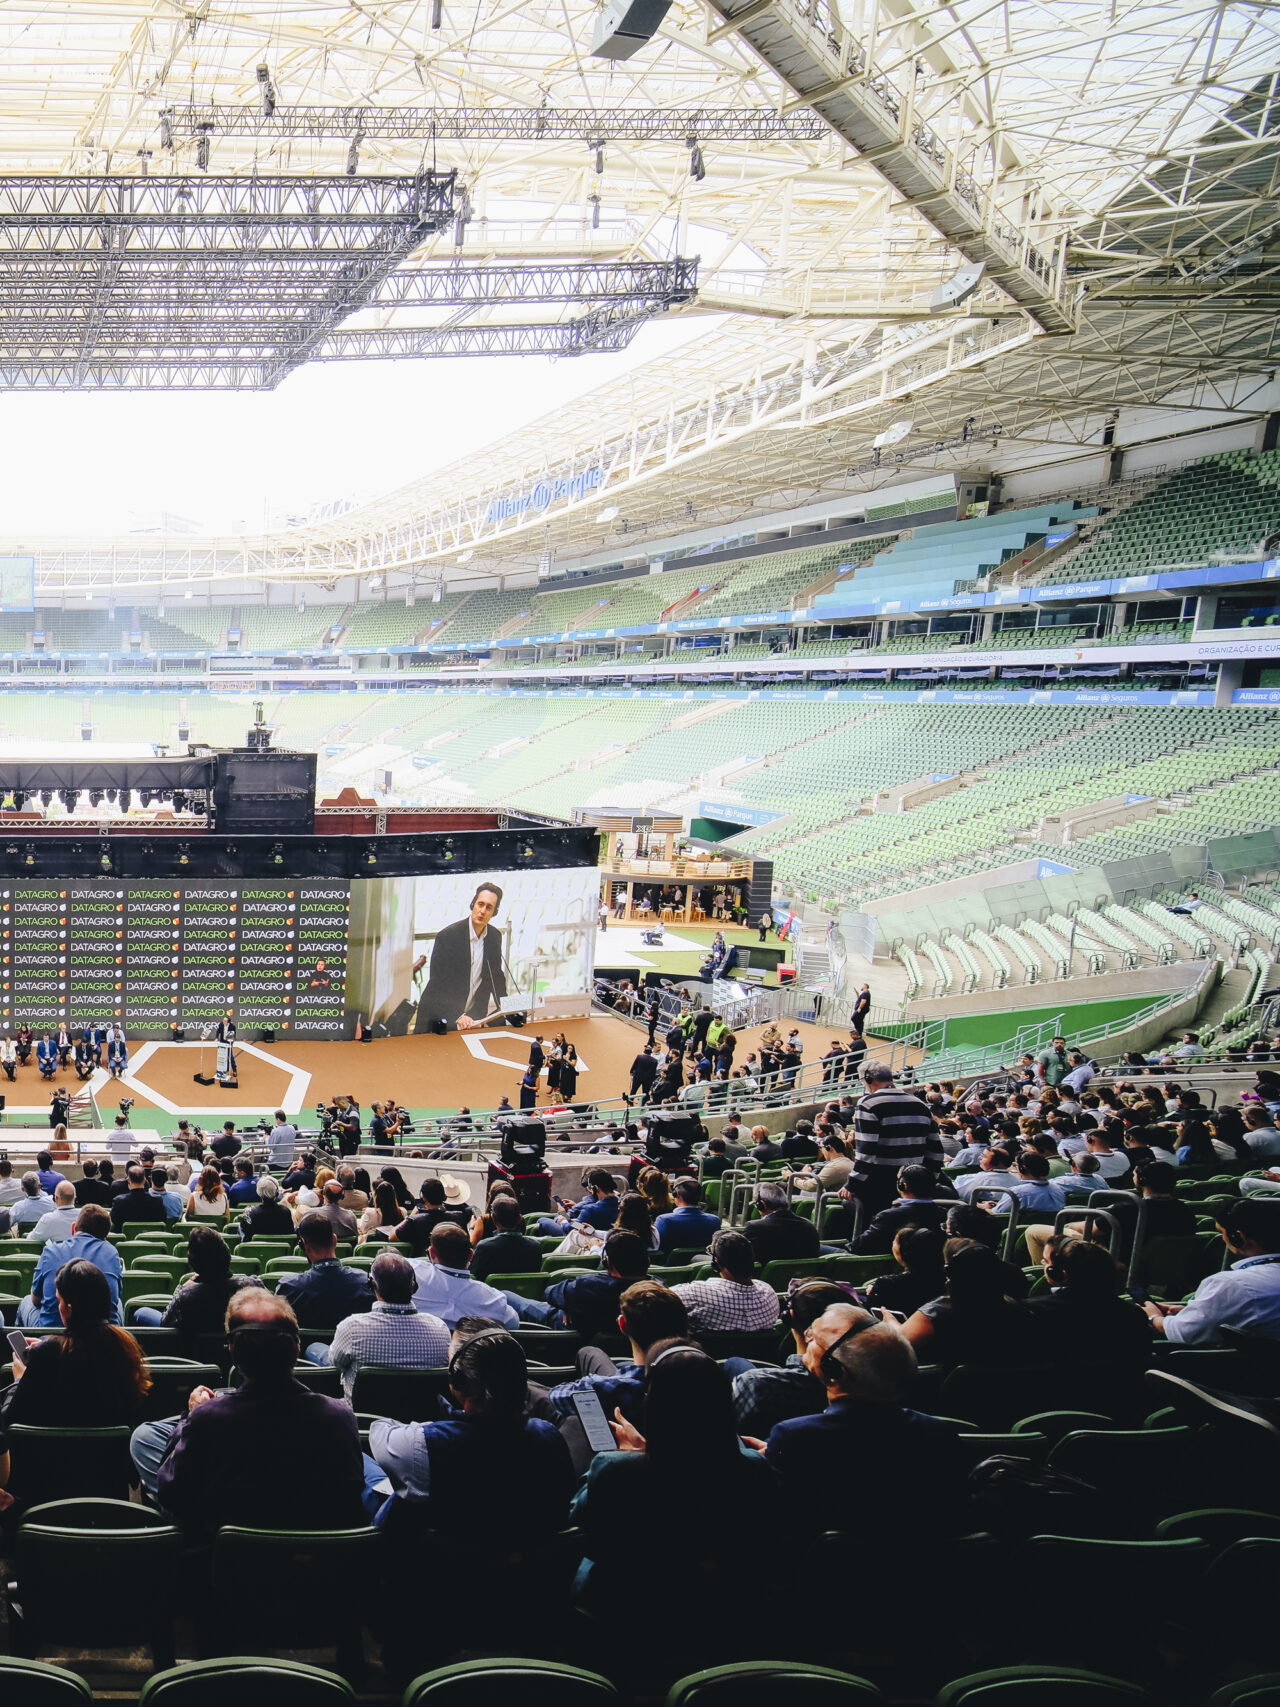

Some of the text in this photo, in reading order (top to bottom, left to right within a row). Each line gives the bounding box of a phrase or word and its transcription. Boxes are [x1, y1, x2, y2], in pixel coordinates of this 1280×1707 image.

[487, 468, 604, 523] Allianz Parque
[1039, 585, 1101, 597] Allianz Parque
[950, 598, 973, 607] Seguros
[1198, 645, 1256, 654] ORGANIZAÇÃO
[982, 693, 1005, 701] Seguros
[1110, 694, 1138, 703] Seguros
[1239, 692, 1268, 700] Allianz
[703, 805, 753, 820] Allianz Parque
[301, 891, 345, 899] DATAGRO
[243, 904, 287, 912] DATAGRO
[301, 904, 344, 912] DATAGRO
[15, 943, 57, 951] DATAGRO
[71, 943, 114, 951] DATAGRO
[184, 943, 227, 951] DATAGRO
[15, 956, 57, 964] DATAGRO
[127, 956, 170, 964] DATAGRO
[15, 982, 57, 990] DATAGRO
[127, 982, 170, 990] DATAGRO
[70, 996, 113, 1004] DATAGRO
[182, 996, 225, 1004] DATAGRO
[239, 996, 281, 1004] DATAGRO
[296, 996, 340, 1004] DATAGRO
